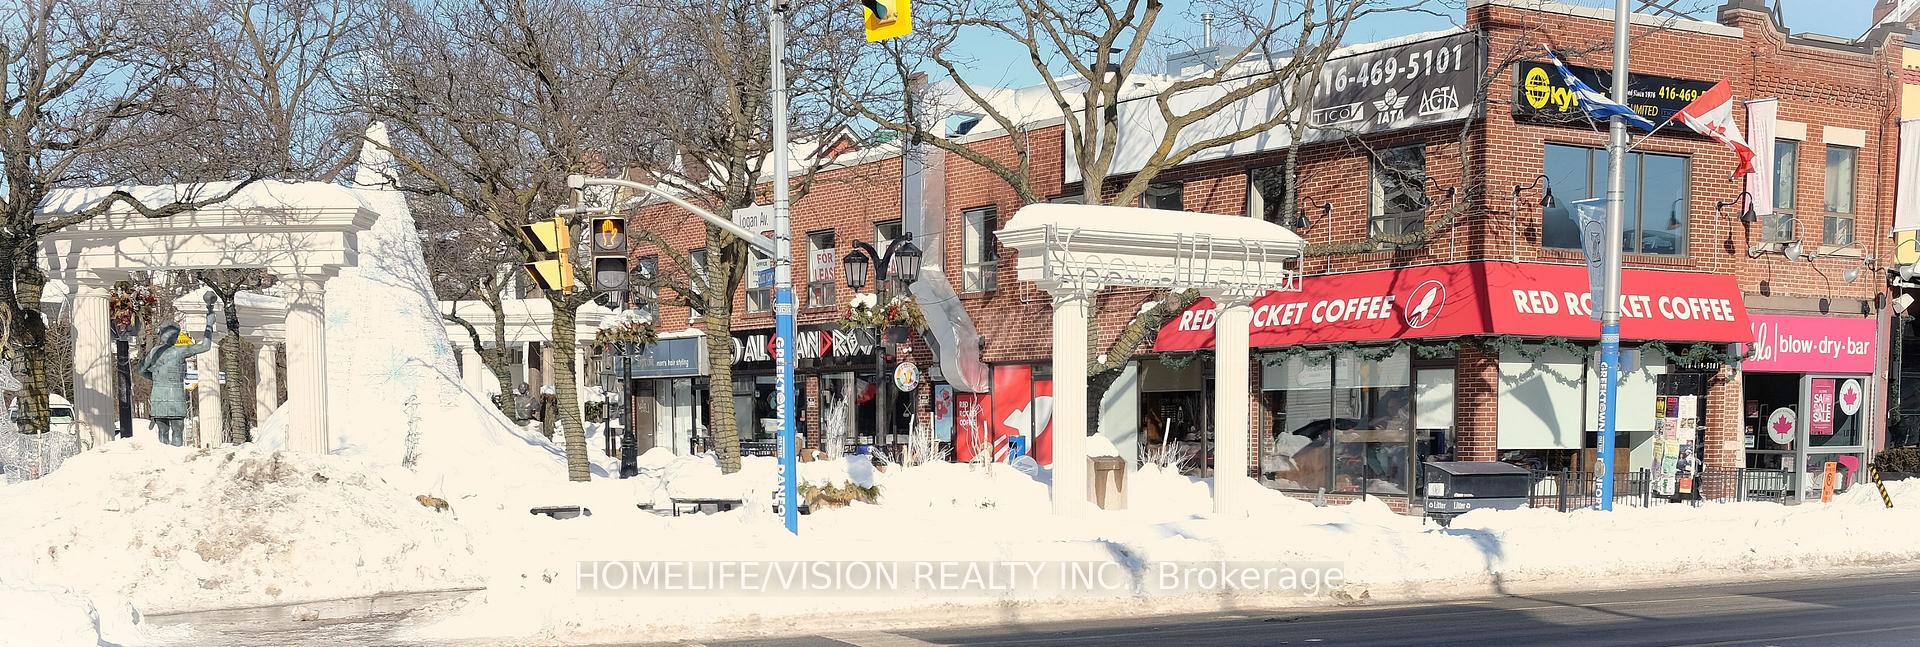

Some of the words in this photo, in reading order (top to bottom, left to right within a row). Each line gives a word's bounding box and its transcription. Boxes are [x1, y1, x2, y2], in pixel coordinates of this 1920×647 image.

[1313, 44, 1462, 97] 16-469-5101
[1419, 85, 1460, 116] ACTA
[1314, 109, 1351, 124] TICO
[1377, 109, 1405, 124] IATA
[740, 214, 758, 229] Logan
[816, 253, 834, 264] FOR
[1178, 309, 1217, 331] RED
[1310, 295, 1396, 324] COFFEE
[1512, 289, 1559, 315] RED
[1564, 291, 1653, 318] ROKET
[1658, 296, 1736, 322] COFFEE
[1812, 412, 1831, 423] SALE
